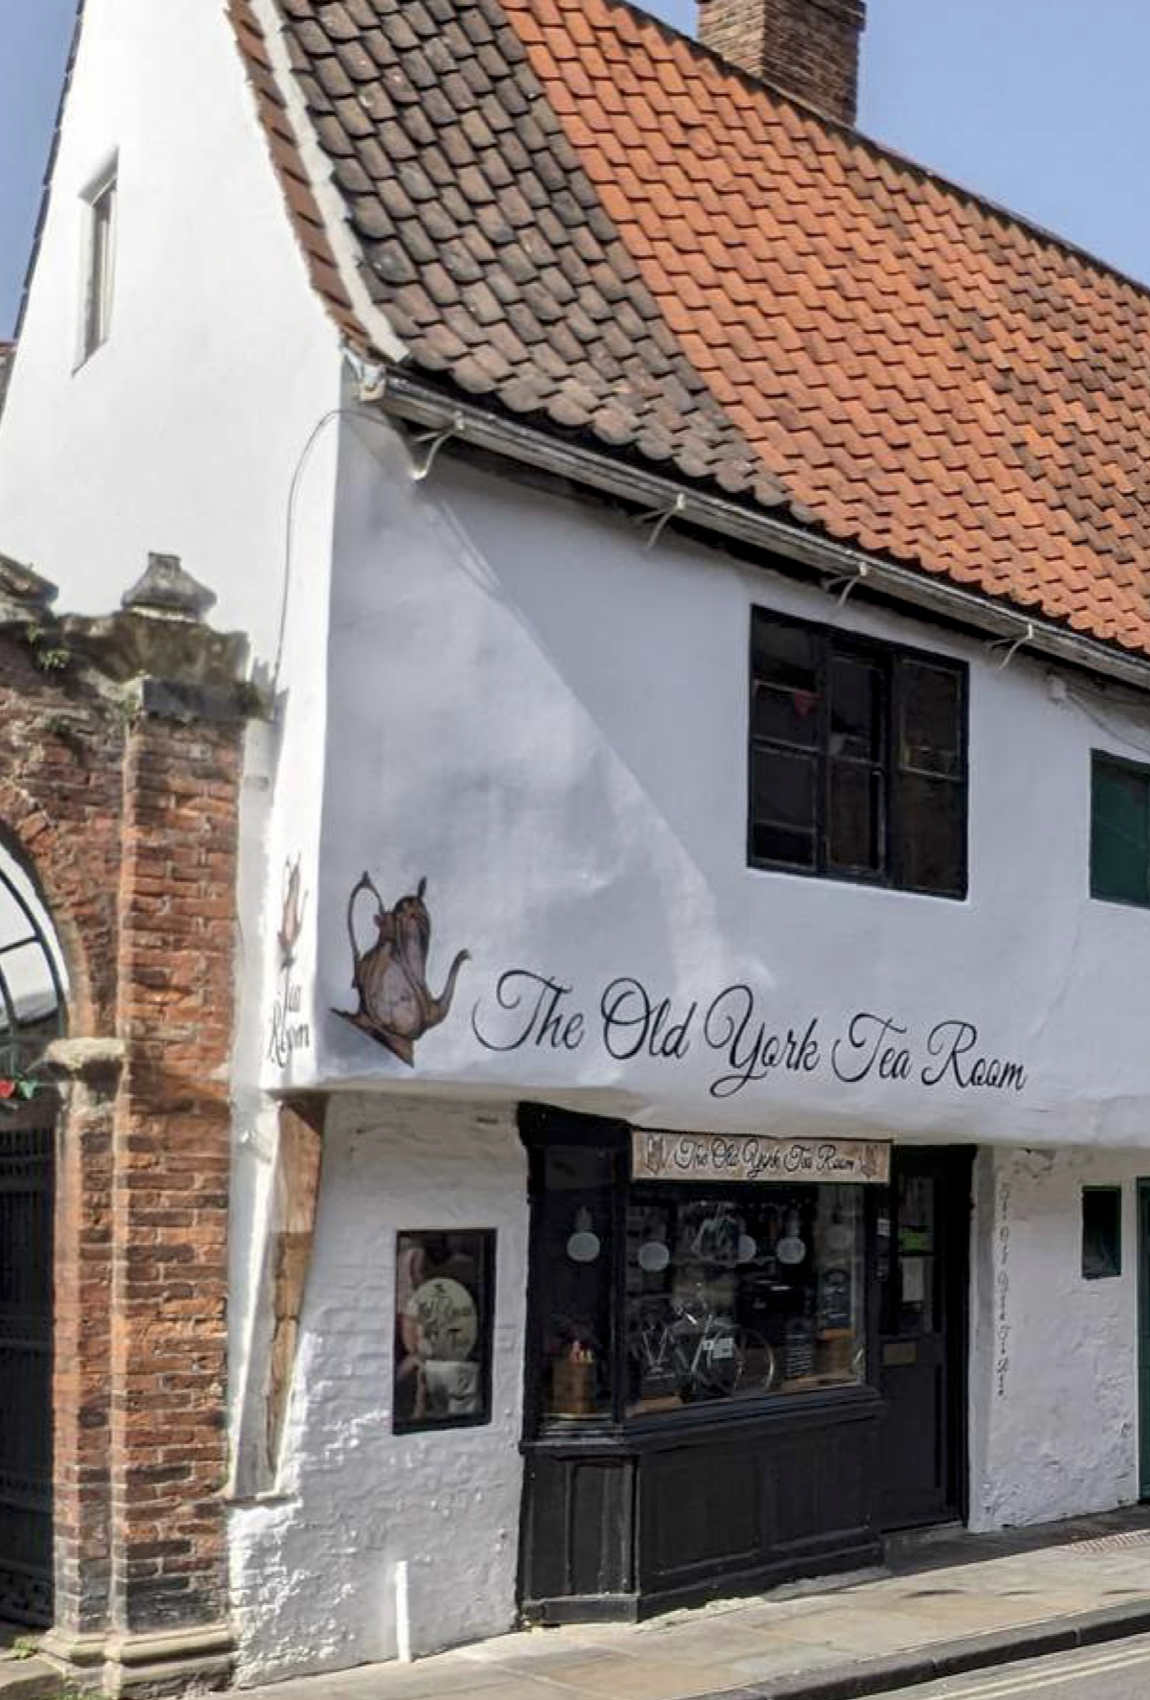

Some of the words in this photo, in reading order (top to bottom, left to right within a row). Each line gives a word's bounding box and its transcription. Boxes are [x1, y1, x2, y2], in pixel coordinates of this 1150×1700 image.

[471, 969, 584, 1052] The
[600, 977, 698, 1059] Old
[703, 984, 821, 1097] York
[831, 1012, 912, 1082] Tea
[921, 1019, 1029, 1090] Room
[673, 1137, 709, 1169] The
[711, 1136, 739, 1168] Old
[742, 1137, 783, 1178] York
[783, 1144, 813, 1172] Tea
[816, 1143, 855, 1171] Room
